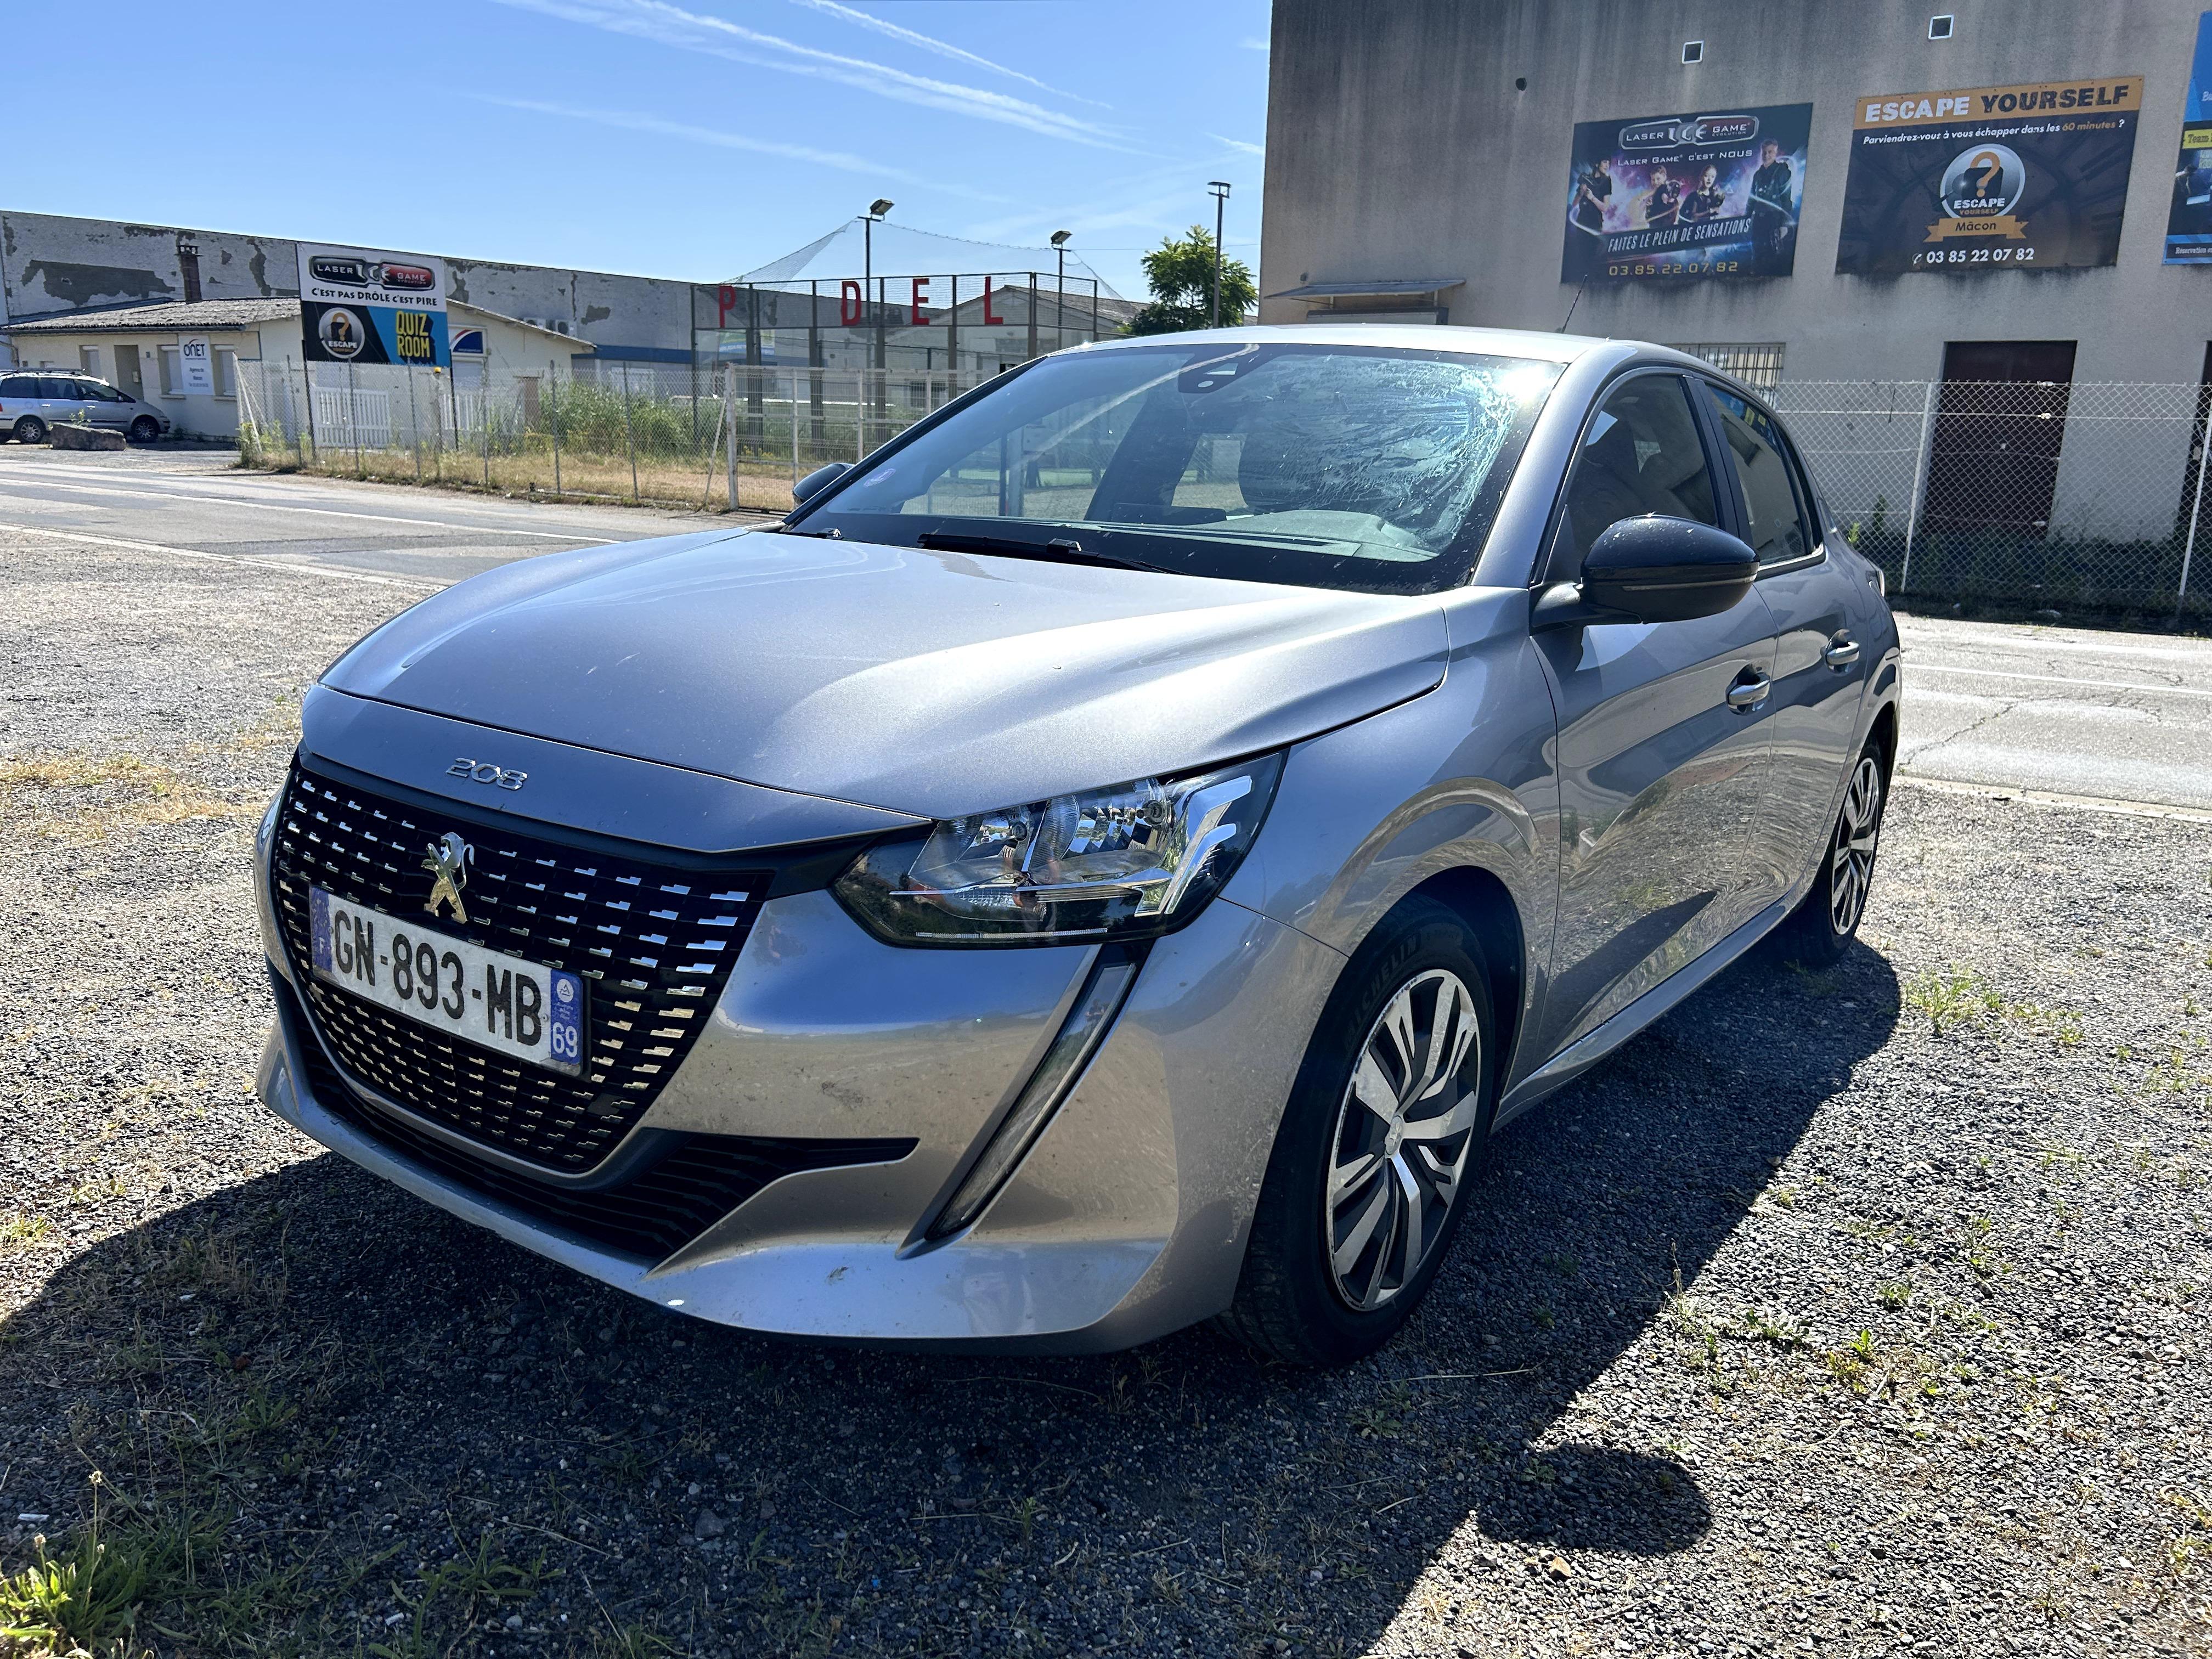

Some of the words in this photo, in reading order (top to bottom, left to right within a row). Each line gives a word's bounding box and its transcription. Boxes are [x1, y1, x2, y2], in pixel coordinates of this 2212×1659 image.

[1865, 96, 1970, 122] ESCAPE
[1981, 85, 2129, 113] YOURSELF
[1626, 132, 1664, 142] LASER
[1712, 123, 1747, 133] GAME
[1863, 132, 1940, 144] Parviendrez-vous
[1943, 131, 1949, 139] à
[1976, 127, 2019, 138] échapper
[2021, 125, 2044, 133] dans
[2046, 123, 2060, 132] les
[2062, 122, 2075, 131] 60
[2077, 121, 2115, 130] minutes
[2118, 119, 2125, 127] ?
[1719, 149, 1753, 158] NOUS
[1954, 198, 2006, 209] ESCAPE
[1607, 234, 1637, 252] FAITES
[1640, 233, 1651, 248] LE
[1652, 228, 1679, 246] PLEIN
[1680, 227, 1694, 242] DE
[1694, 218, 1751, 240] SENSATIONS
[1955, 221, 1997, 232] Mâcon
[1926, 251, 1944, 264] 03
[1948, 250, 1966, 263] 85
[1971, 249, 1989, 262] 22
[1993, 249, 2012, 261] 07
[2016, 247, 2034, 261] 82
[317, 264, 353, 274] LASER
[397, 272, 427, 281] GAME
[1609, 261, 1738, 276] 03.85.22.07.82
[312, 288, 336, 297] C'EST
[338, 290, 354, 299] PAS
[357, 291, 390, 302] DRÔLE
[392, 296, 414, 304] C'EST
[416, 297, 437, 306] PIRE
[396, 311, 429, 336] QUIZ
[397, 336, 431, 358] ROOM
[445, 757, 528, 790] 208
[319, 937, 325, 953] F
[334, 910, 542, 1046] GN-893-MB
[552, 1022, 578, 1058] 69
